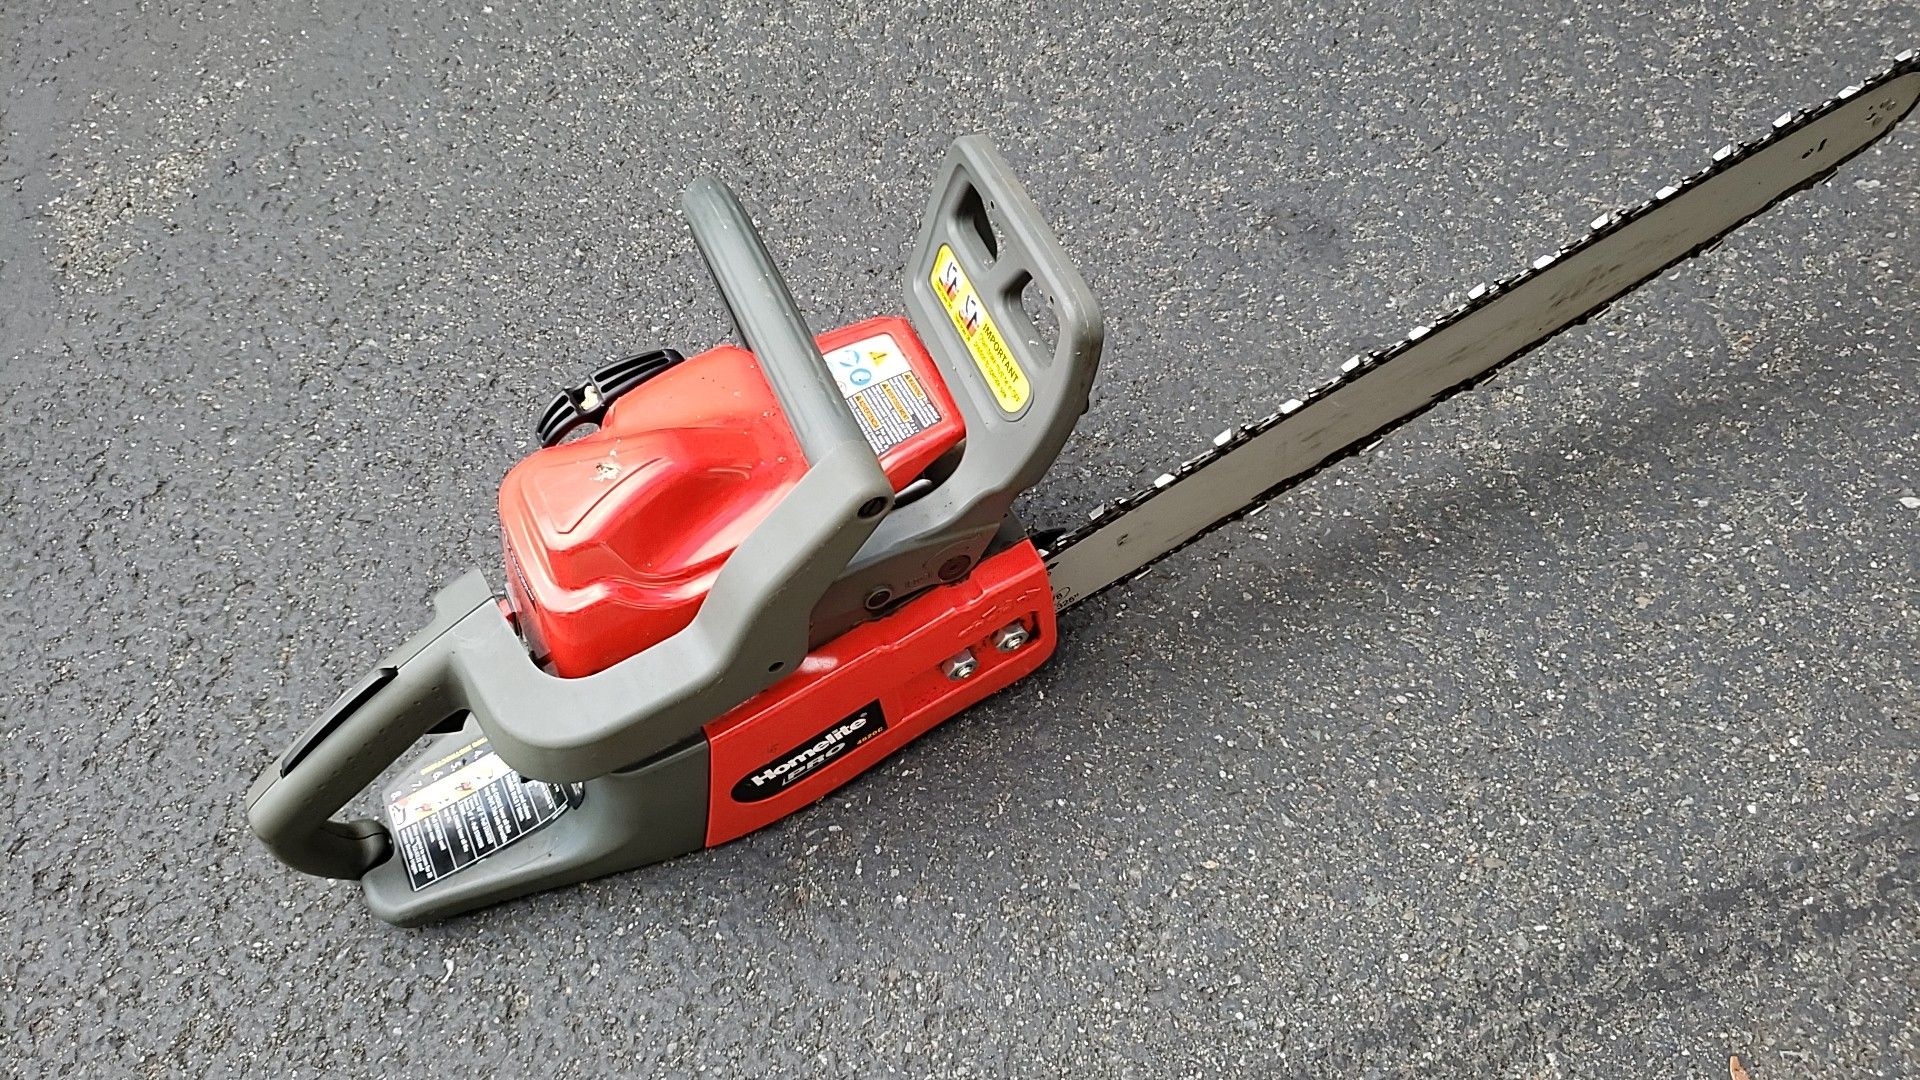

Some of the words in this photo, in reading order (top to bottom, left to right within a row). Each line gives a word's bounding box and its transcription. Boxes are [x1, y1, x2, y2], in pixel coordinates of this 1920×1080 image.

[983, 324, 1018, 383] IMPORTANT
[751, 718, 867, 787] Homelite
[787, 742, 846, 781] PRO
